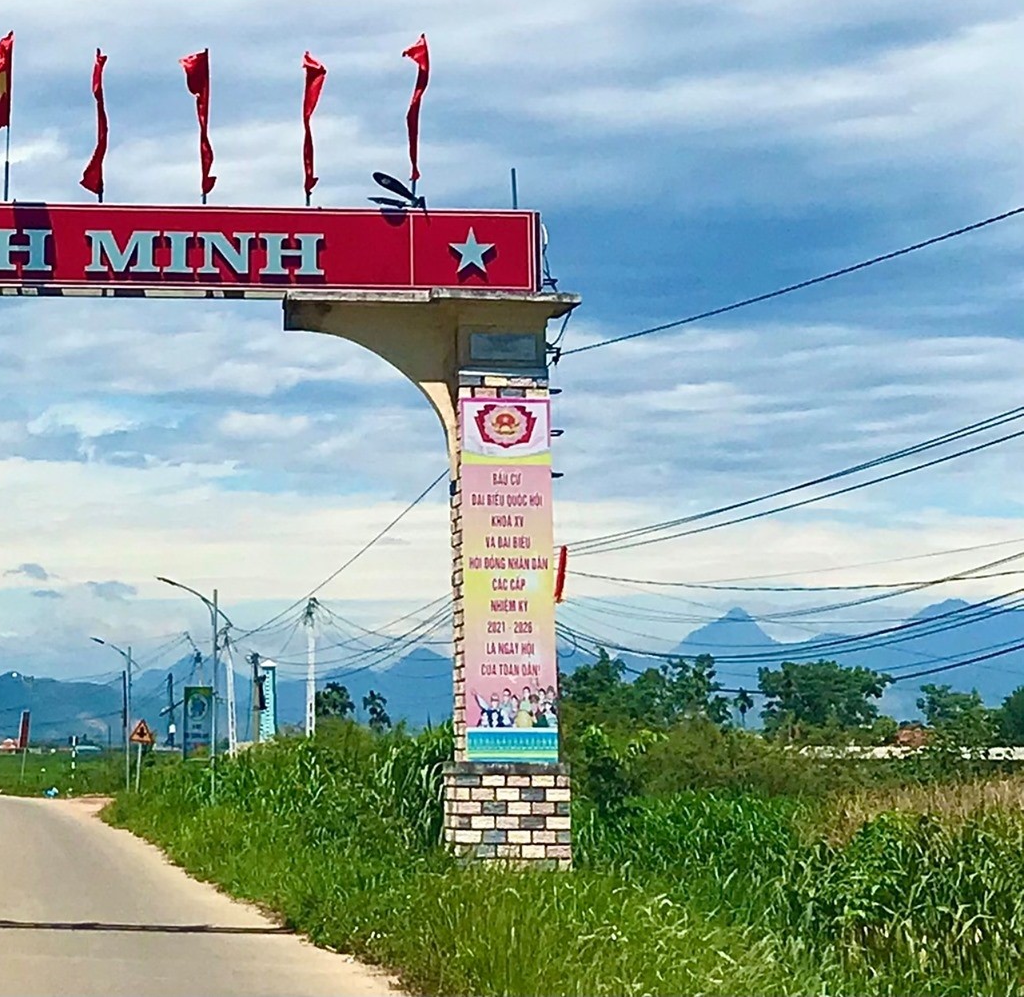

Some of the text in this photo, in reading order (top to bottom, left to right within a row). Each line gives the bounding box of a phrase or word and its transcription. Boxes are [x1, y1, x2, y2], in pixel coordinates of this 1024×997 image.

[84, 230, 324, 275] MINH
[487, 621, 505, 633] 2021
[514, 621, 533, 633] 2026
